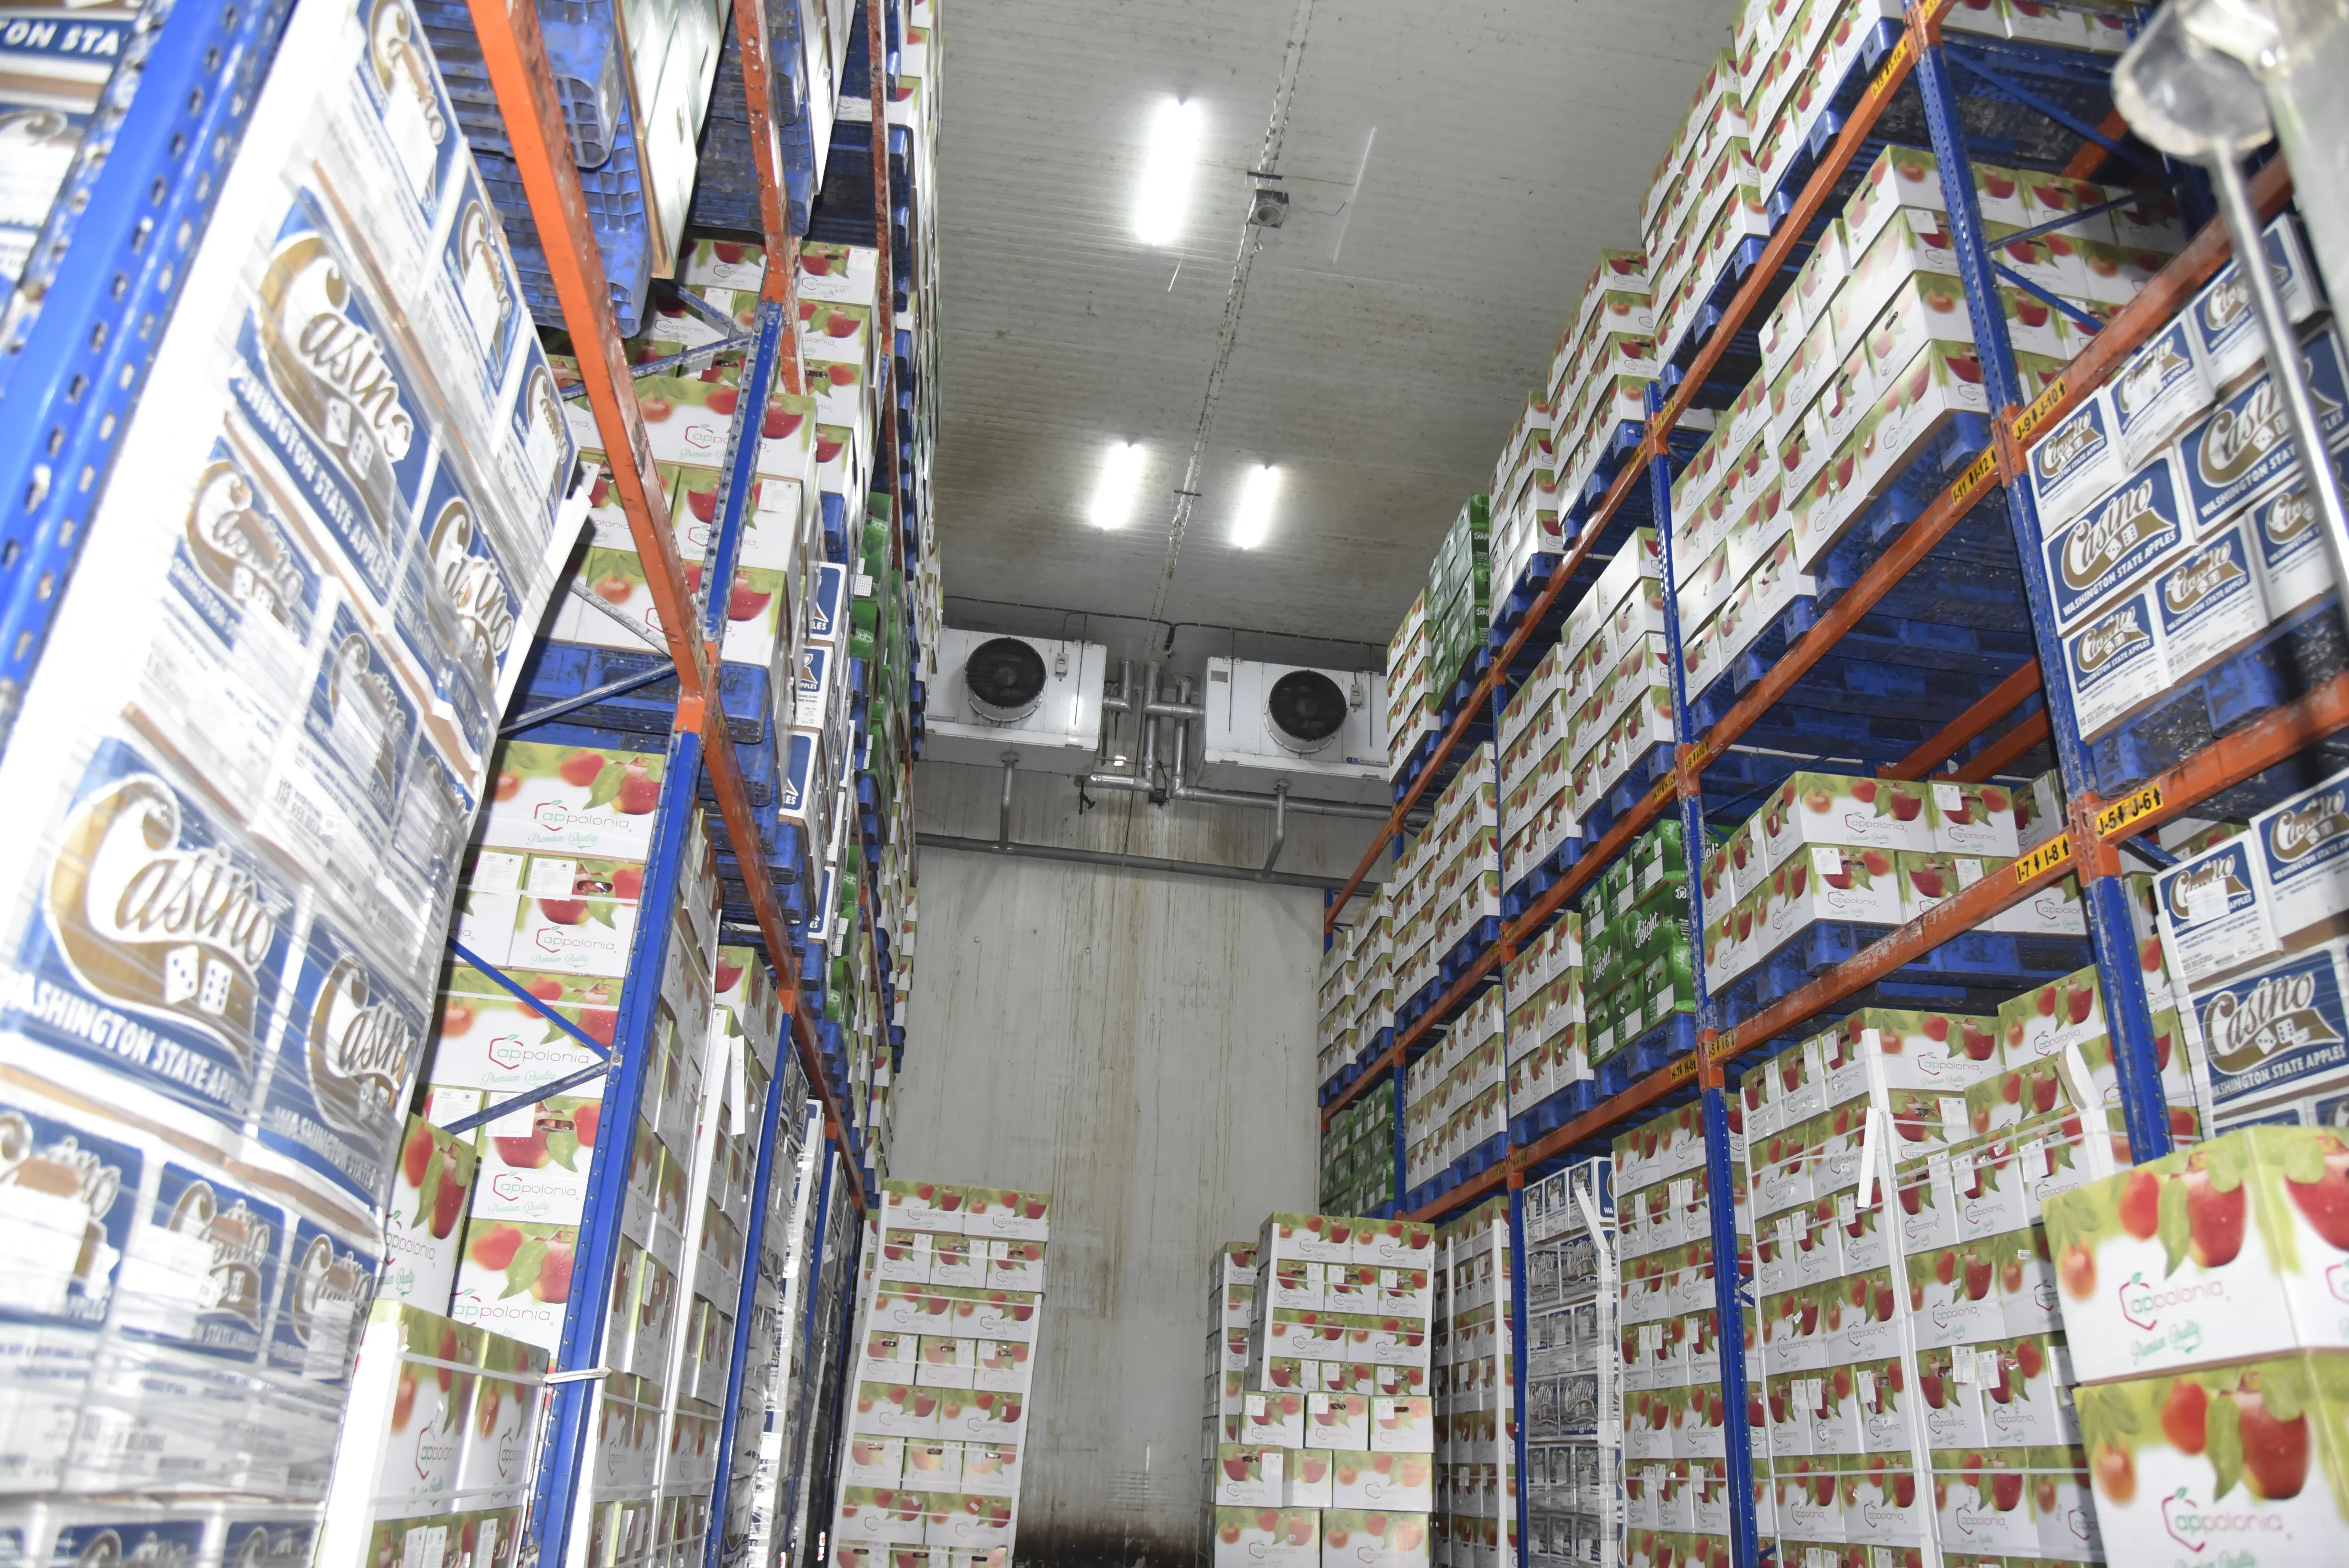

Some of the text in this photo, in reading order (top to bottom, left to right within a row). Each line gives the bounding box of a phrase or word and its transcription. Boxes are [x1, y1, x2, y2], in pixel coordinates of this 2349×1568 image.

[718, 267, 761, 278] appolonia
[659, 323, 704, 334] appolonia
[284, 254, 414, 462] Casino
[2017, 388, 2058, 440] J-9 J-10
[1888, 404, 1921, 443] appolonia
[1953, 458, 1989, 503] I-11 I-12
[2200, 444, 2296, 517] WASHINGTON STAT
[313, 470, 352, 536] STATE
[1818, 492, 1846, 526] appolonia
[2070, 478, 2153, 575] Casino
[2062, 530, 2176, 616] WASHINGTON STATE APPLES
[1476, 608, 1490, 617] Delig
[2167, 576, 2247, 631] WASHINGTON STATE APPLES
[2078, 639, 2150, 689] WASHINGTON STATE APPLES
[1696, 745, 1704, 760] I-10
[542, 809, 629, 830] appolonia
[2098, 792, 2151, 836] J-5 J-6
[1852, 820, 1905, 832] appolonia
[526, 832, 599, 846] Premium Quality
[1846, 833, 1890, 843] Premium Quality
[1954, 831, 1995, 842] appolonia
[2017, 844, 2058, 881] I-7 I-8
[86, 797, 276, 975] Casino
[1833, 897, 1877, 906] appolonia
[2229, 894, 2252, 910] APPLES
[1775, 902, 1799, 924] appolonia
[1635, 911, 1659, 948] Delight
[544, 934, 615, 950] appolonia
[531, 953, 590, 965] Premium Quality
[1592, 945, 1611, 983] Delight
[1722, 945, 1745, 965] appolonia
[2211, 971, 2315, 1056] Casino
[2039, 1028, 2080, 1050] appolonia
[153, 1037, 211, 1088] STATE
[497, 1047, 589, 1064] appolonia
[1684, 1059, 1694, 1074] H-8
[1924, 1060, 1979, 1072] appolonia
[2212, 1044, 2346, 1099] ASHINGTON STATE APPLES
[480, 1070, 557, 1086] Premium Quality
[1921, 1076, 1964, 1087] Premium Quality
[501, 1182, 577, 1196] appolonia
[1768, 1178, 1795, 1193] appolonia
[488, 1202, 550, 1215] Premium Quality
[911, 1211, 947, 1219] appolonia
[1969, 1203, 2003, 1219] appolonia
[996, 1219, 1031, 1228] appolonia
[386, 1233, 435, 1260] appolonia
[1567, 1240, 1595, 1274] Casino
[1804, 1256, 1827, 1267] appolonia
[1530, 1252, 1554, 1285] Casino
[2131, 1281, 2224, 1313] appolonia
[453, 1302, 551, 1321] appolonia
[1937, 1306, 1977, 1321] appolonia
[1852, 1327, 1885, 1340] appolonia
[1529, 1382, 1553, 1415] Casino
[1565, 1378, 1594, 1412] Casino
[1998, 1415, 2034, 1424] appolonia
[1794, 1509, 1824, 1518] appolonia
[1868, 1511, 1904, 1520] appolonia
[1961, 1516, 2005, 1527] appolonia
[2174, 1514, 2284, 1534] appolonia
[1253, 1547, 1296, 1556] appolonia
